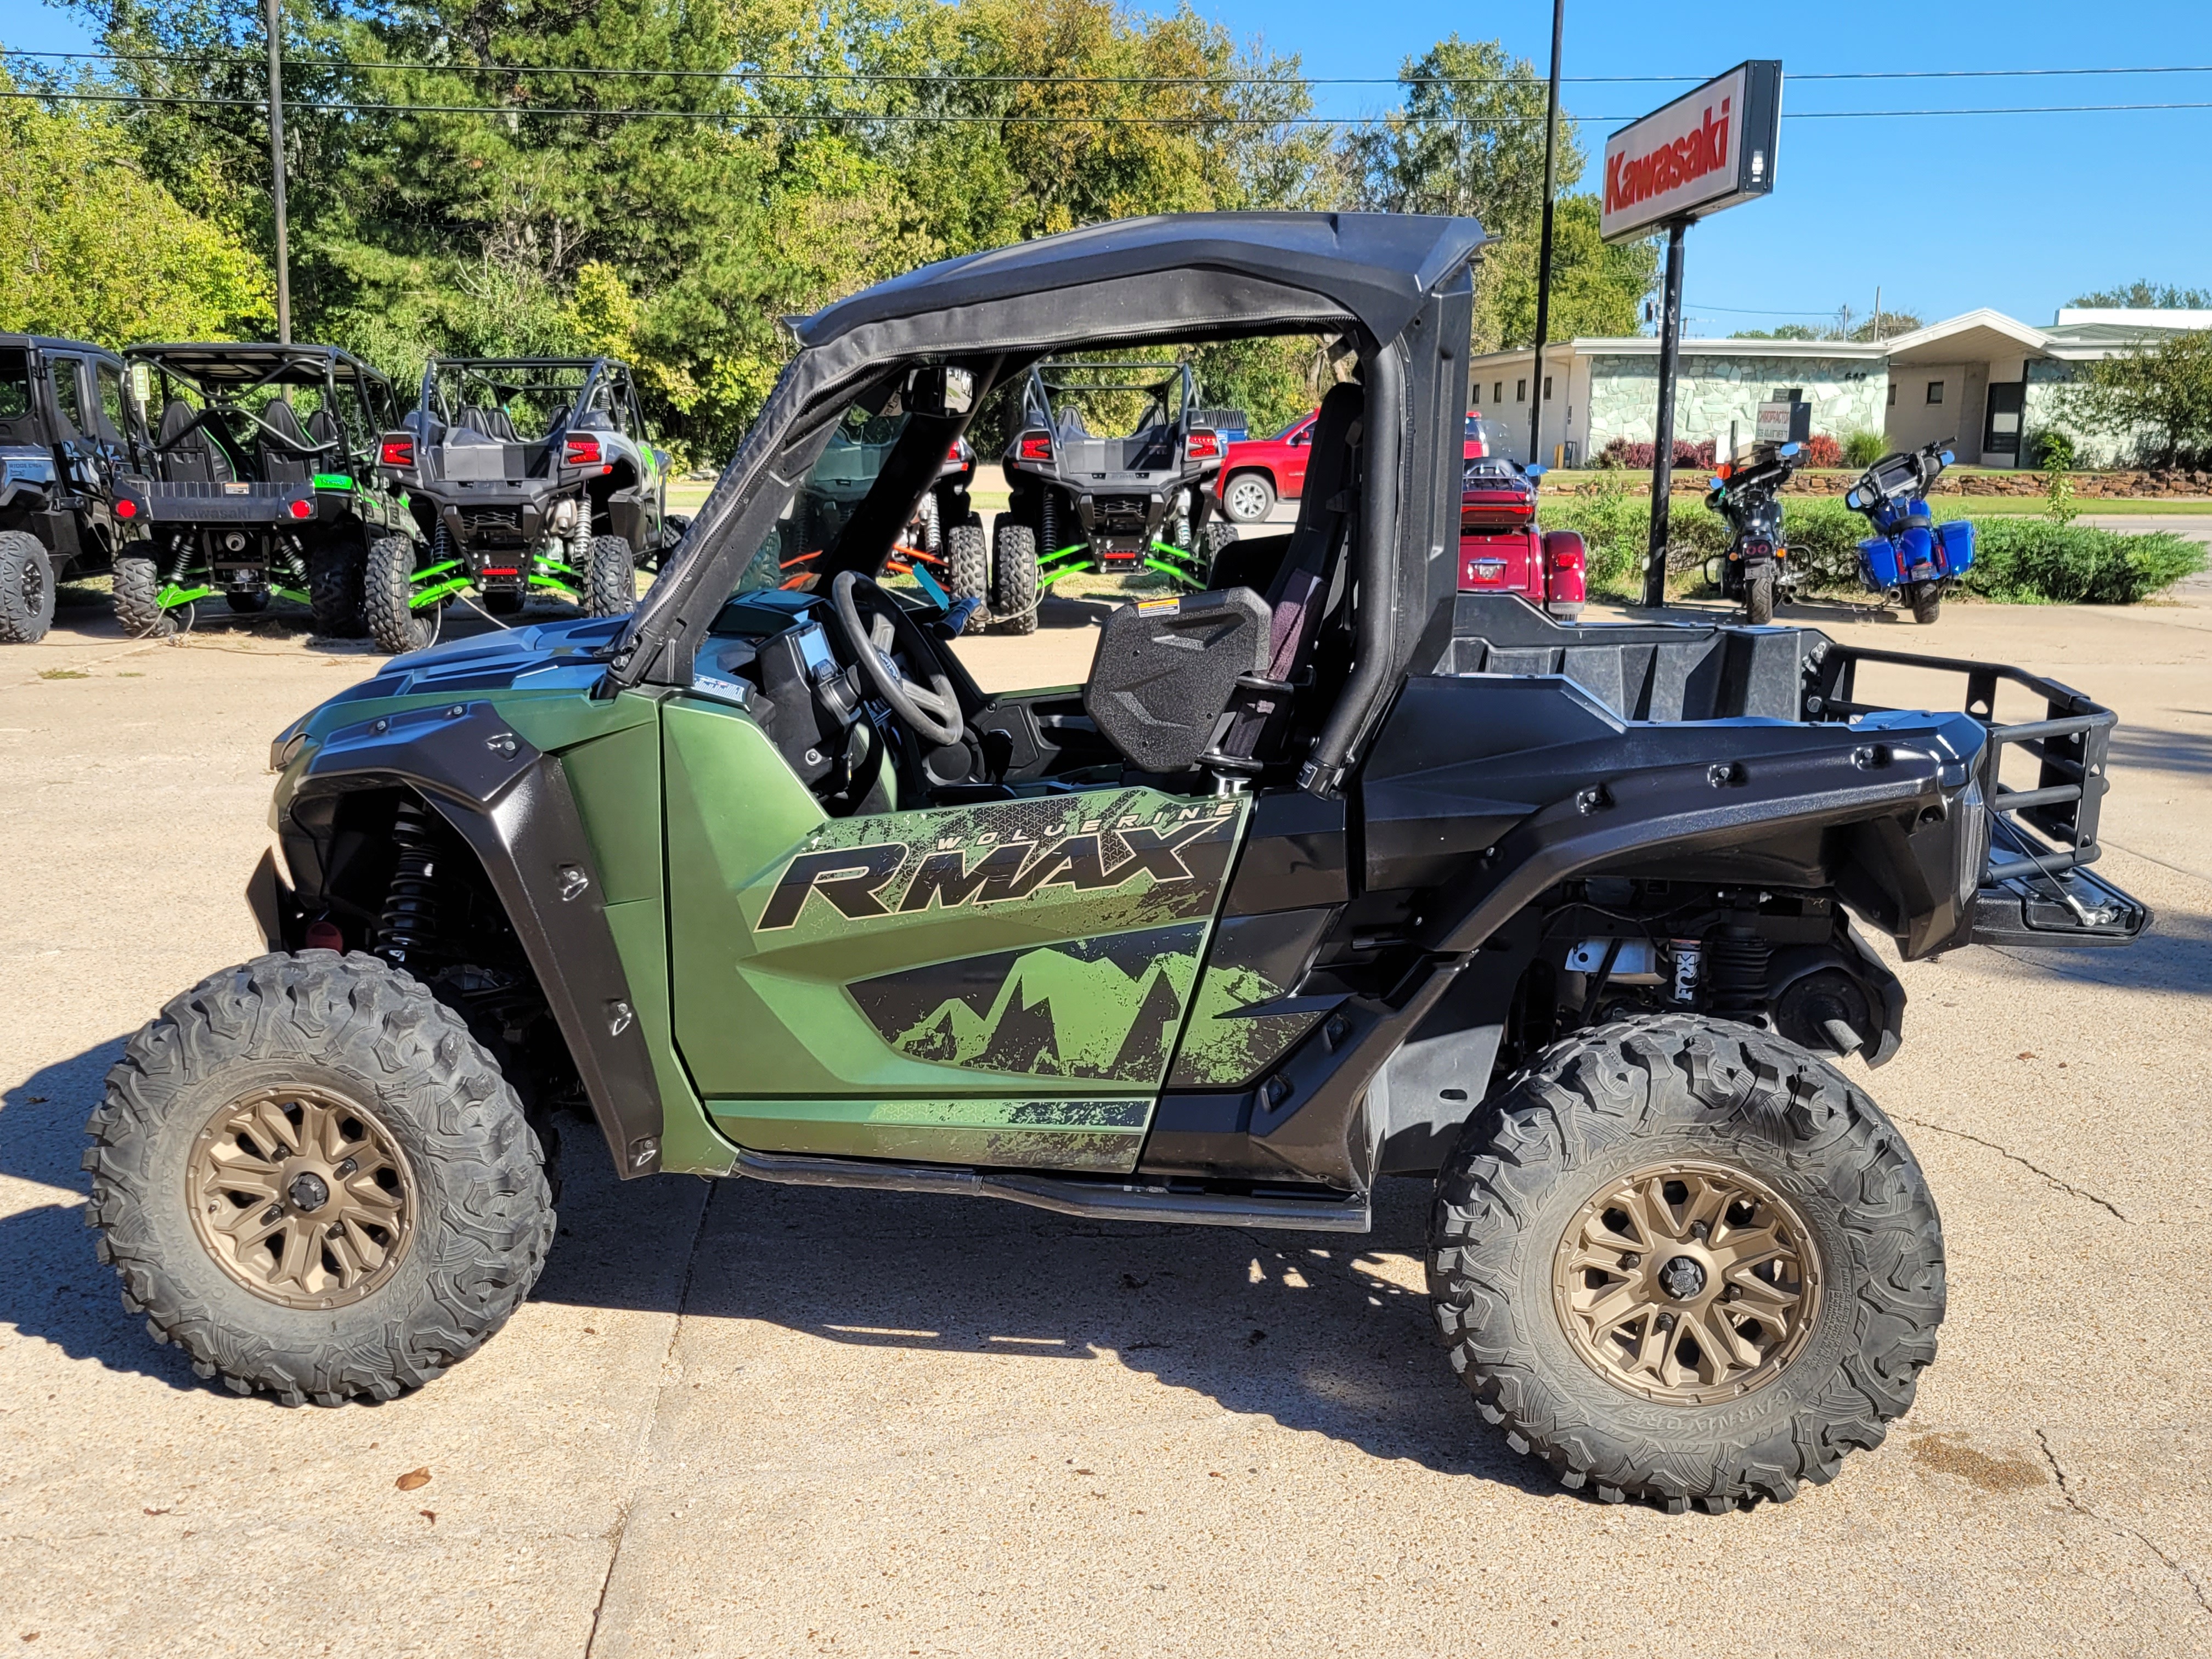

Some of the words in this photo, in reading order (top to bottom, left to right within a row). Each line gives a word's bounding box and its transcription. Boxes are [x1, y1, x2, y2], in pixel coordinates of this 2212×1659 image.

[1605, 95, 1730, 215] Kawasaki
[938, 803, 1237, 850] WOLVERINE
[754, 817, 1228, 932] RMAX
[1675, 955, 1699, 1001] FOX
